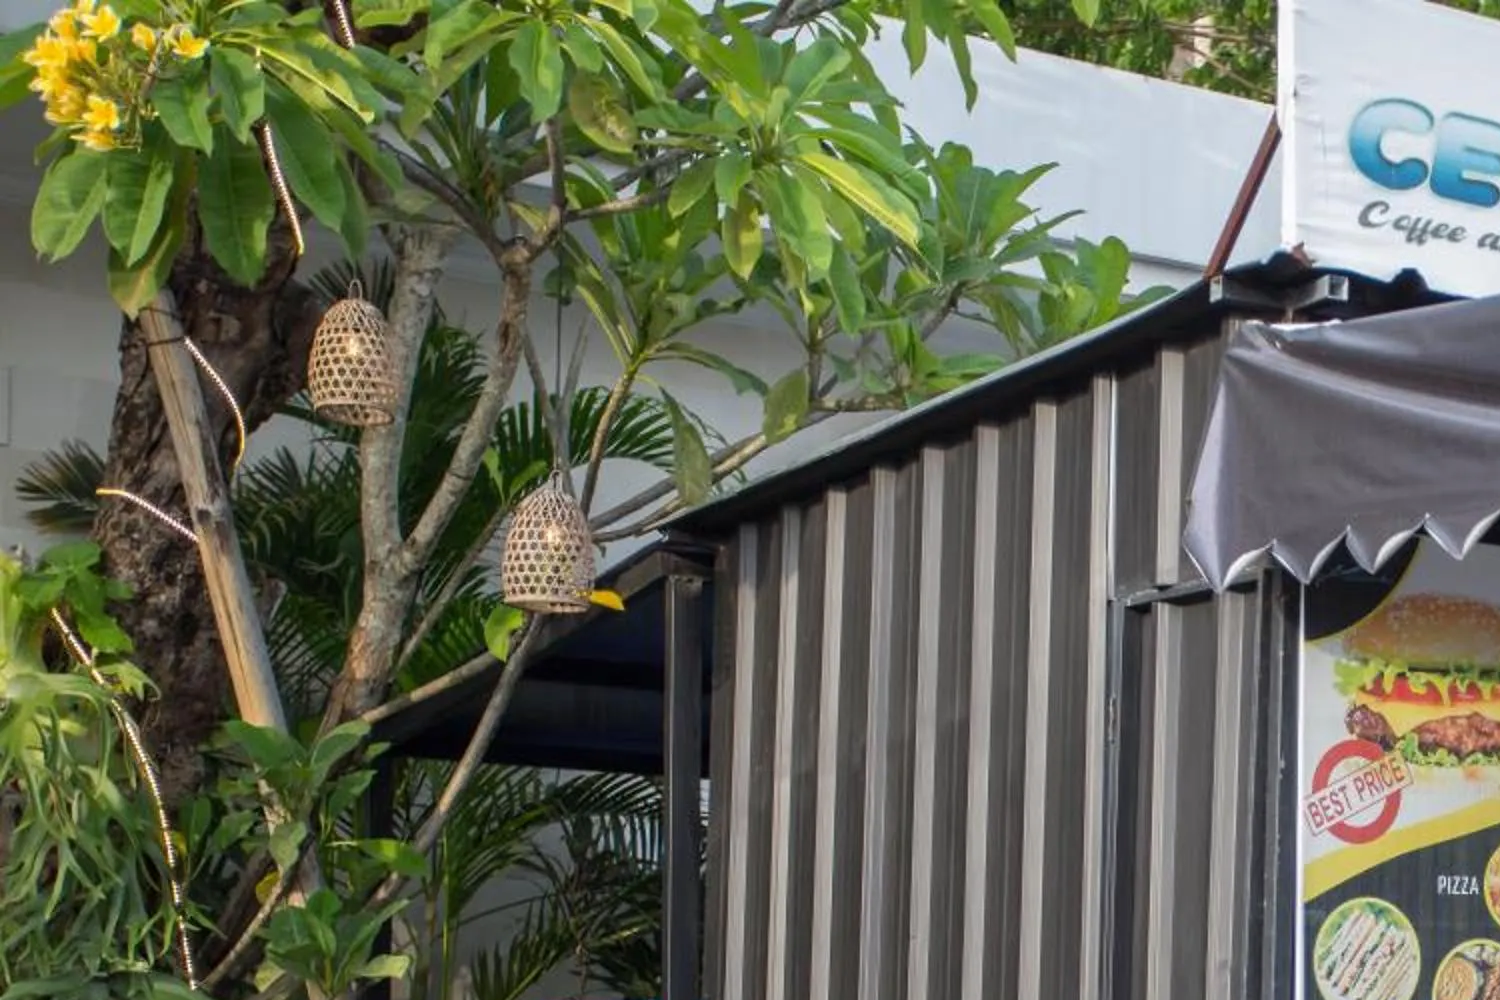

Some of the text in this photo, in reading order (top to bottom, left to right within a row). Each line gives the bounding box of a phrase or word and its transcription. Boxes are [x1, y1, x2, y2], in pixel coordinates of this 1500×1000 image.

[1358, 201, 1467, 246] Coffee
[1306, 757, 1405, 829] BEST PRICE
[1437, 874, 1480, 896] PIZZA
